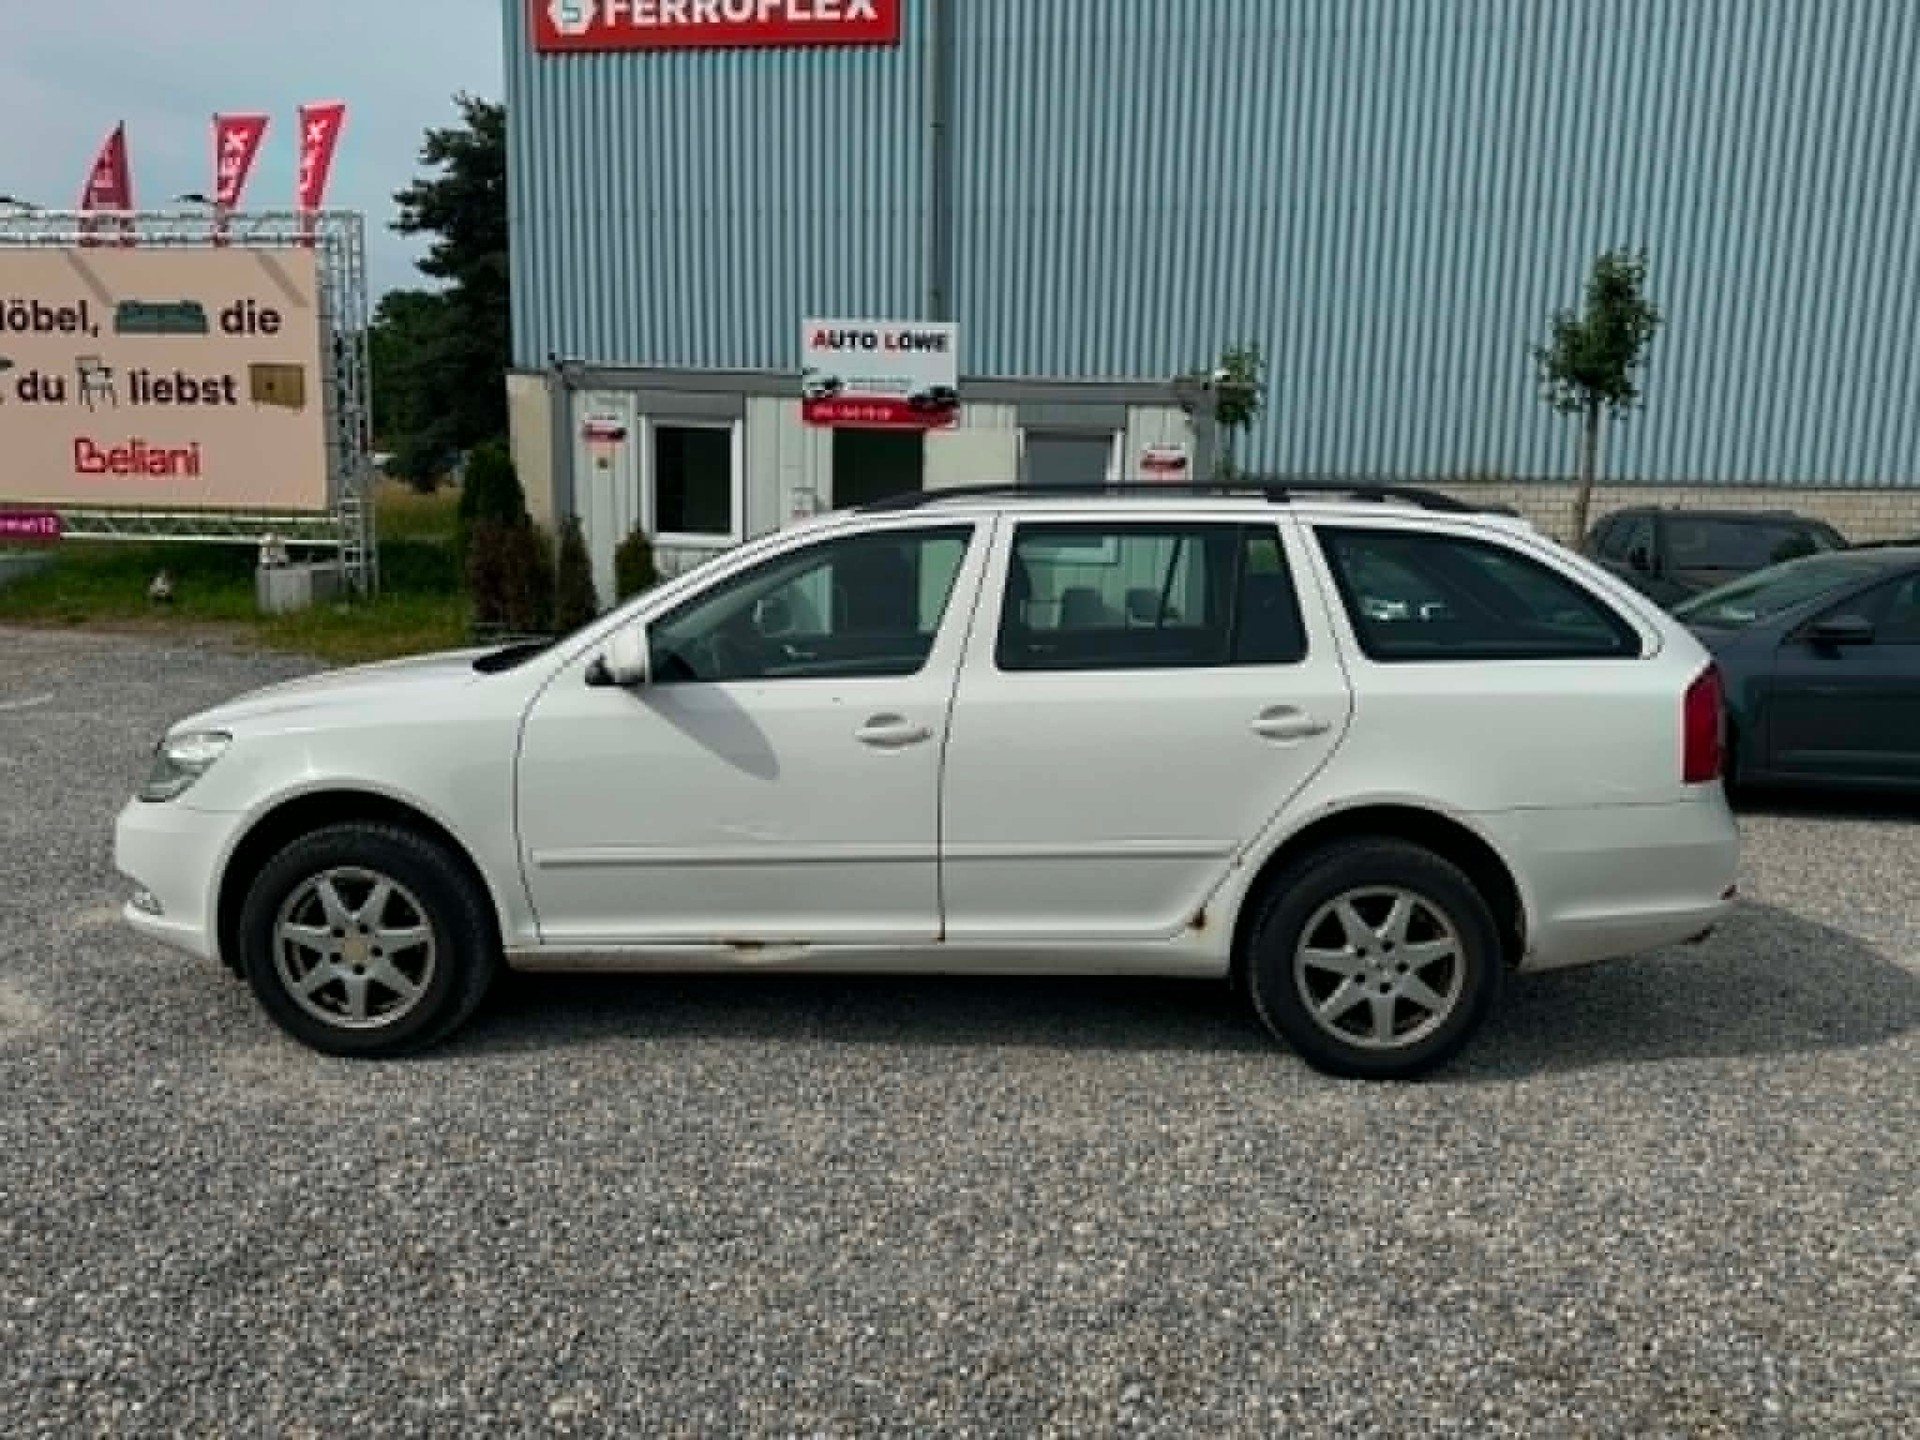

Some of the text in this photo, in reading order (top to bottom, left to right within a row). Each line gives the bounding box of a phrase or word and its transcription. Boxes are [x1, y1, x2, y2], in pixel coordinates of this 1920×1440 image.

[604, 0, 878, 27] FERROFLEX
[0, 298, 282, 338] öbel, die
[811, 329, 878, 350] AUTO
[16, 367, 238, 405] du liebst
[74, 436, 201, 476] Beliani
